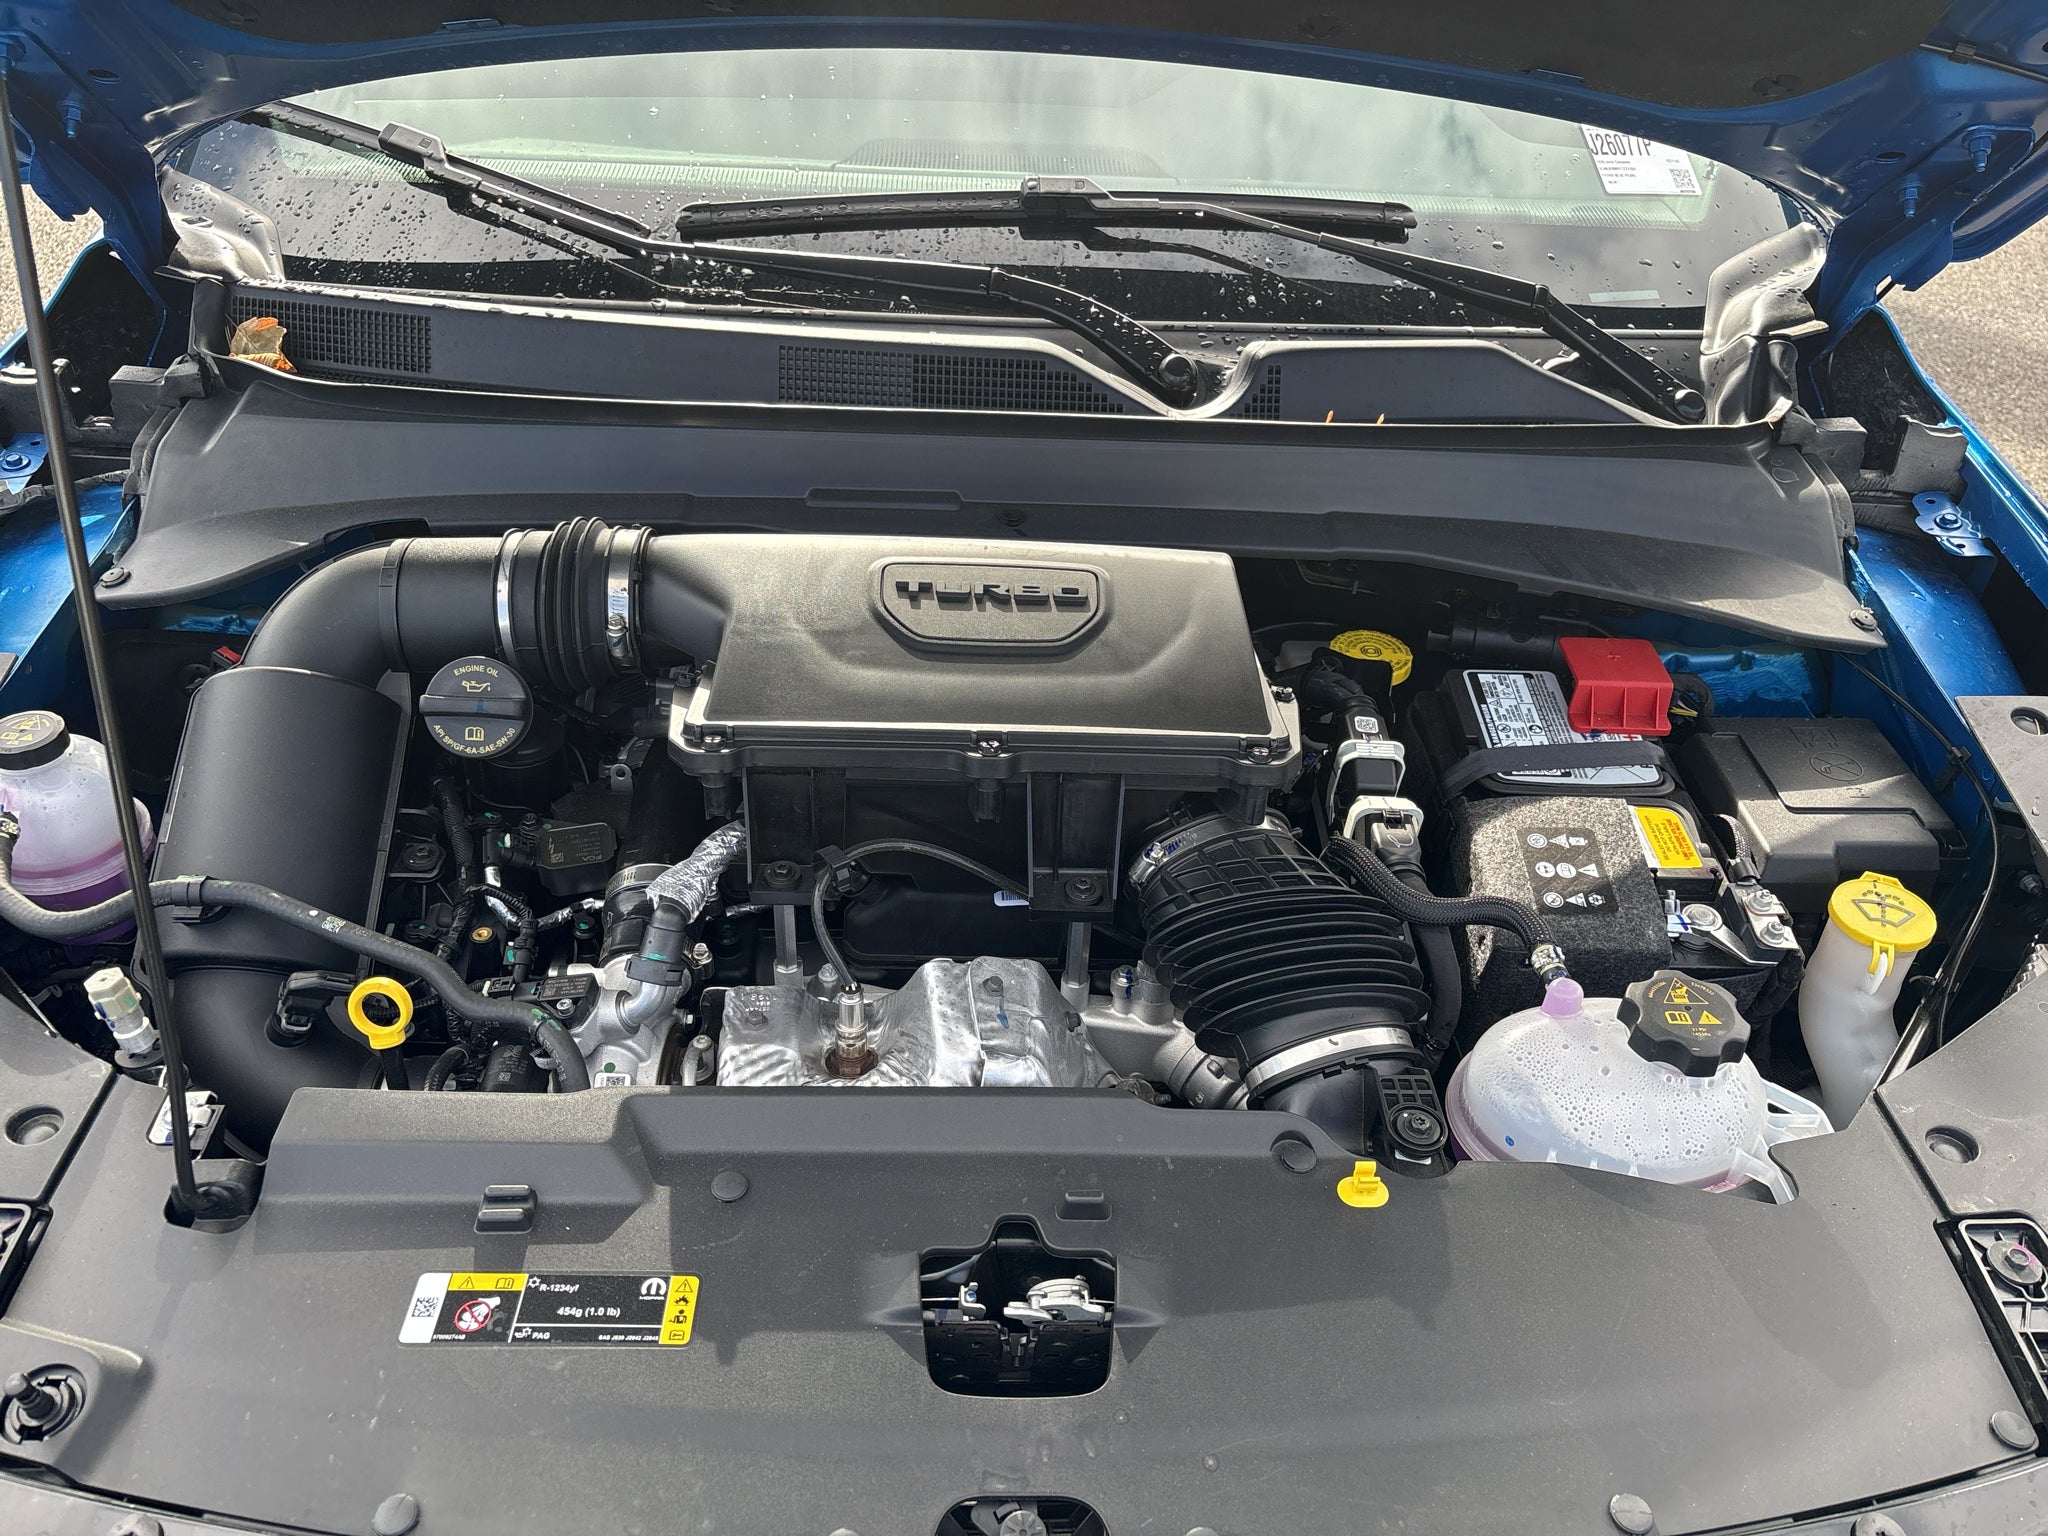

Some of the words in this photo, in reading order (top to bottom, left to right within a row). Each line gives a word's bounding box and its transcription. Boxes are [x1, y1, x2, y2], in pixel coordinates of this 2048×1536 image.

[895, 581, 1089, 606] TURBO
[453, 664, 486, 676] ENGINE
[486, 667, 499, 678] OIL
[433, 724, 446, 738] API
[539, 1284, 579, 1293] R-1234yf
[557, 1307, 583, 1317] 454g
[585, 1307, 605, 1317] (1.0
[607, 1308, 621, 1317] lb)
